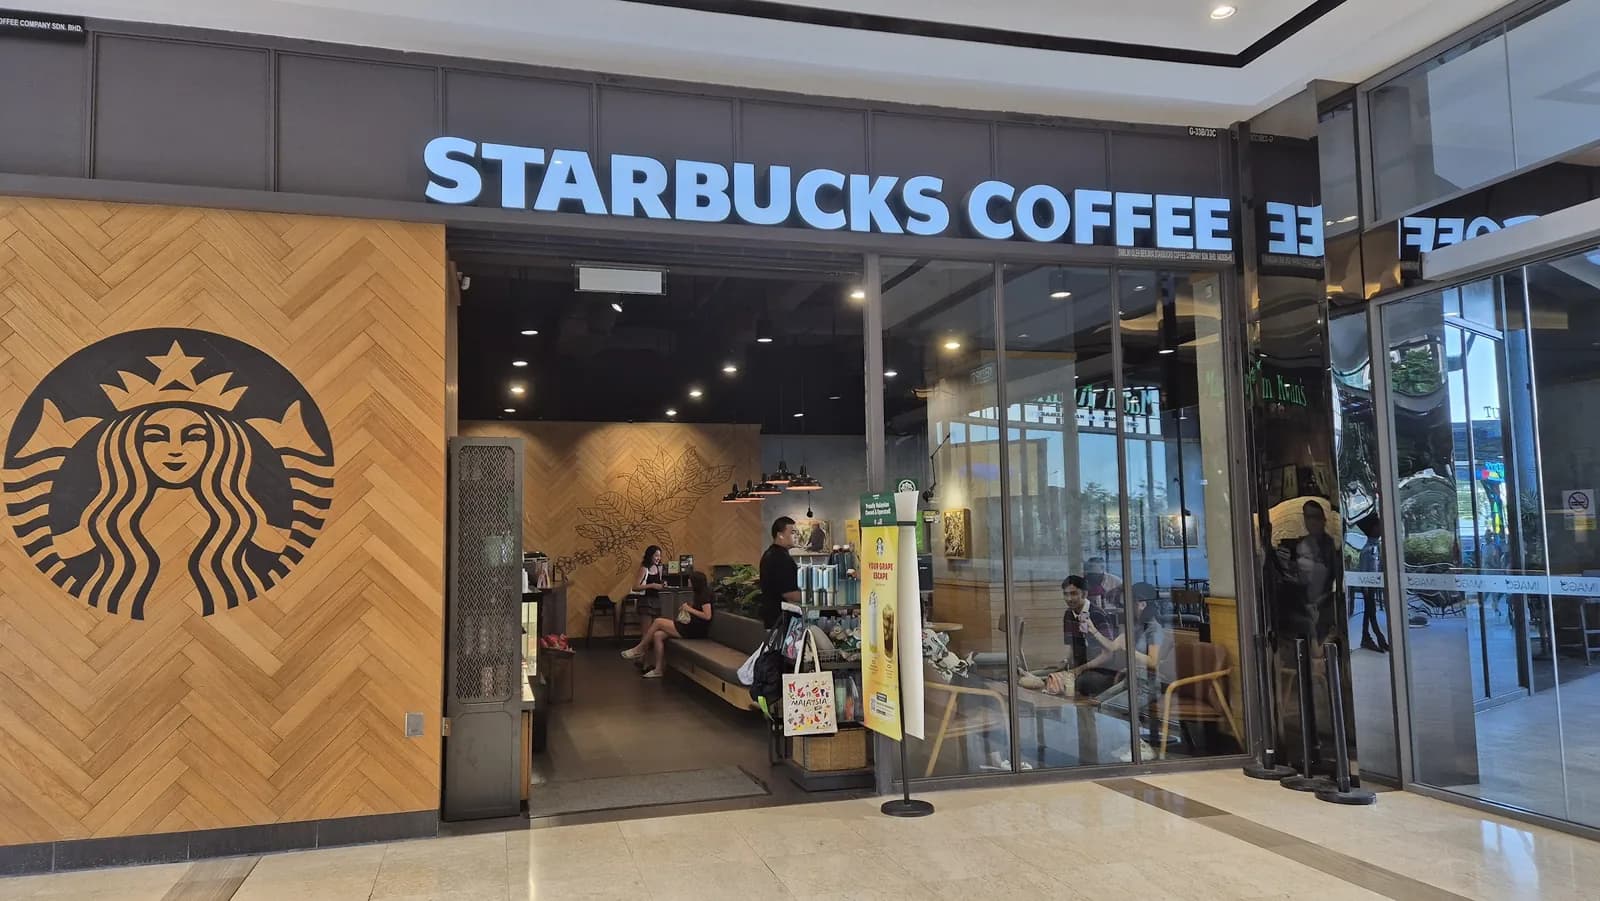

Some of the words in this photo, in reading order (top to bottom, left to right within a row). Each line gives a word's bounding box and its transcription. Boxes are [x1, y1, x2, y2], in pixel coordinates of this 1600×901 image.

[20, 19, 51, 29] COMPANY
[424, 136, 950, 236] STARBUCKS
[967, 180, 1233, 251] COFFEE
